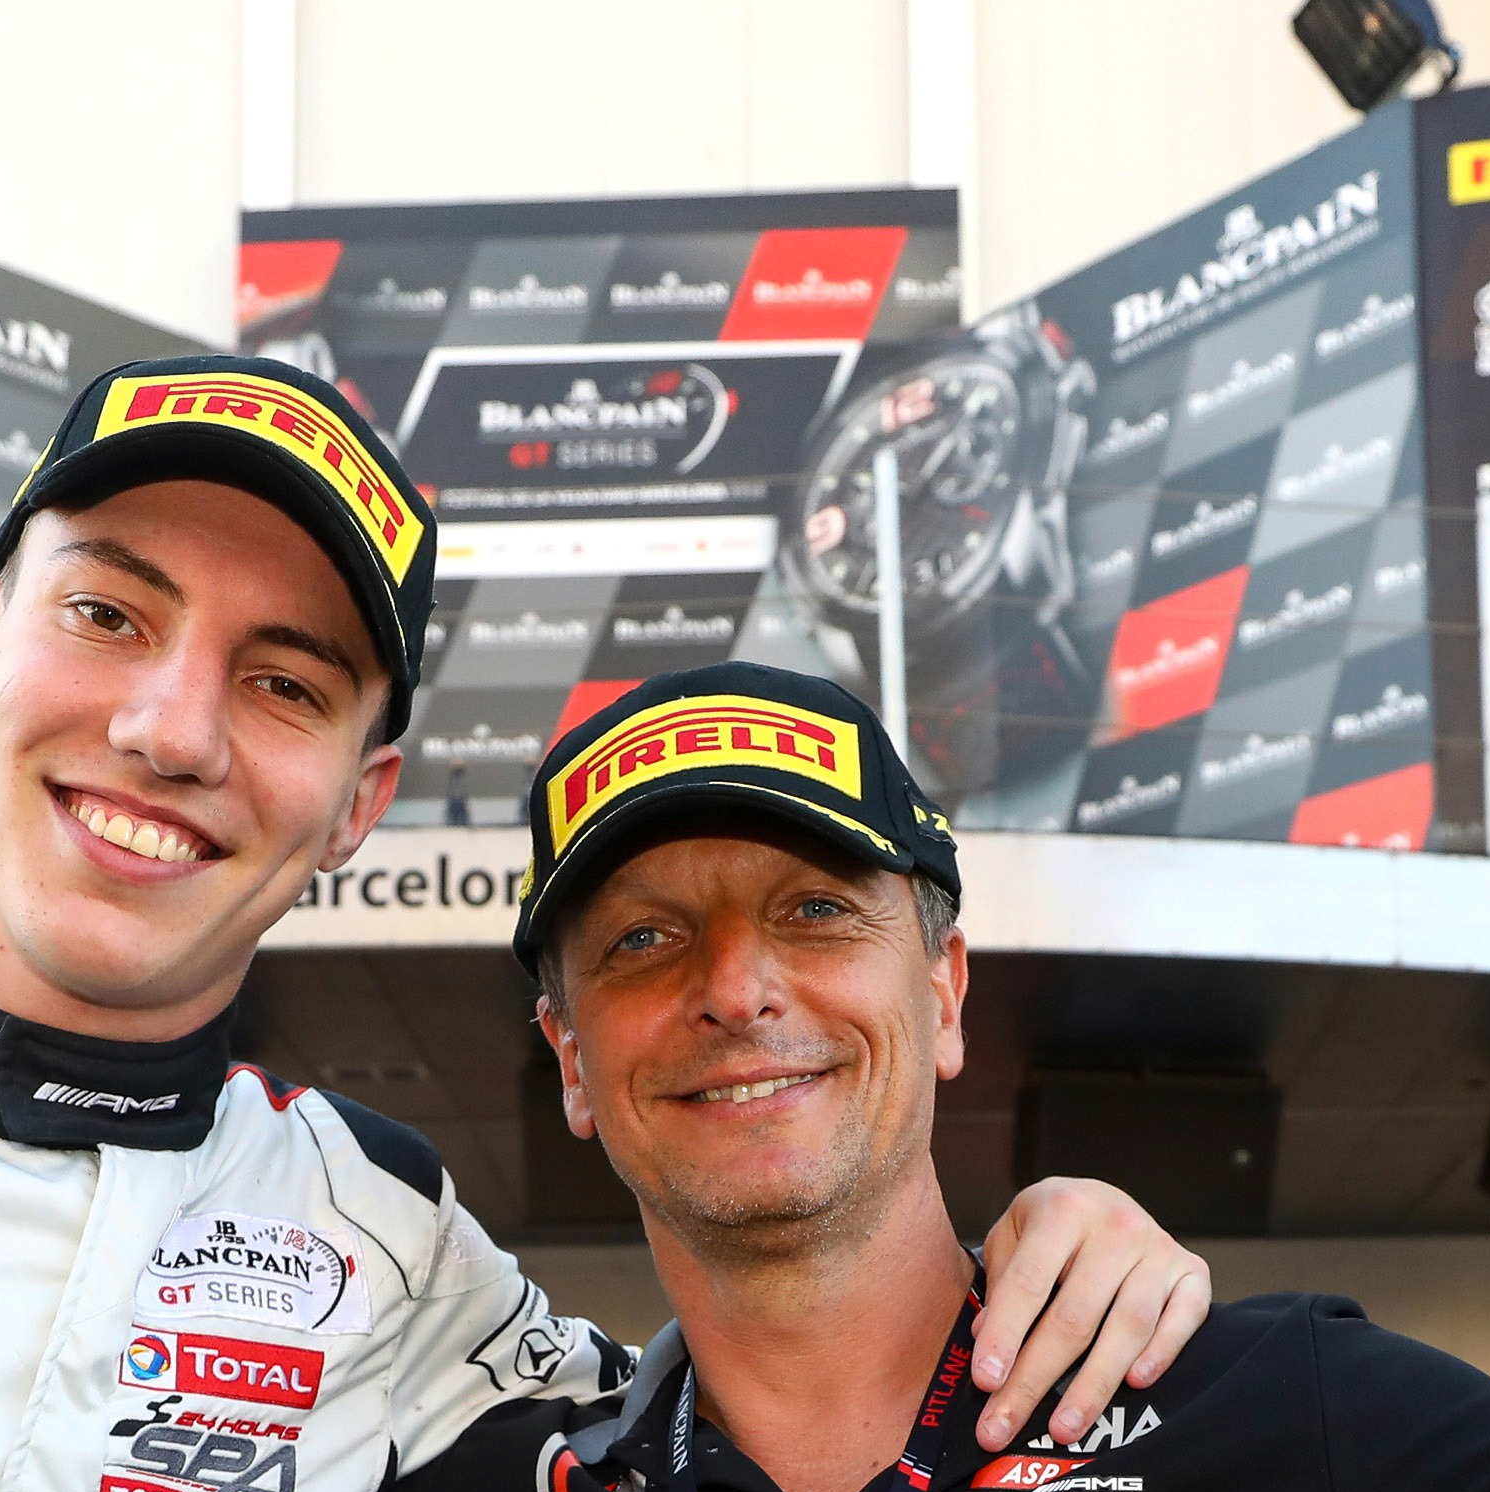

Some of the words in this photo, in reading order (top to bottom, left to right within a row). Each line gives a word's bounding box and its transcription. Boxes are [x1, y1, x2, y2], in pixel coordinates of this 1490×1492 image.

[1112, 170, 1380, 342] BLANCPAIN
[479, 398, 688, 434] BLANCPAIN
[125, 381, 404, 548] PIRELLI
[557, 438, 658, 468] SERIES
[566, 707, 837, 824] PIRELLI
[82, 1091, 181, 1115] AMG
[152, 1246, 311, 1284] LANCPAIN
[158, 1284, 196, 1305] GT
[207, 1281, 294, 1314] SERIES
[183, 1346, 313, 1394] TOTAL
[920, 1343, 972, 1428] PITLANE
[175, 1410, 215, 1430] 24
[216, 1418, 303, 1441] HOURS
[999, 1461, 1062, 1486] ASP
[1064, 1477, 1144, 1492] AMG
